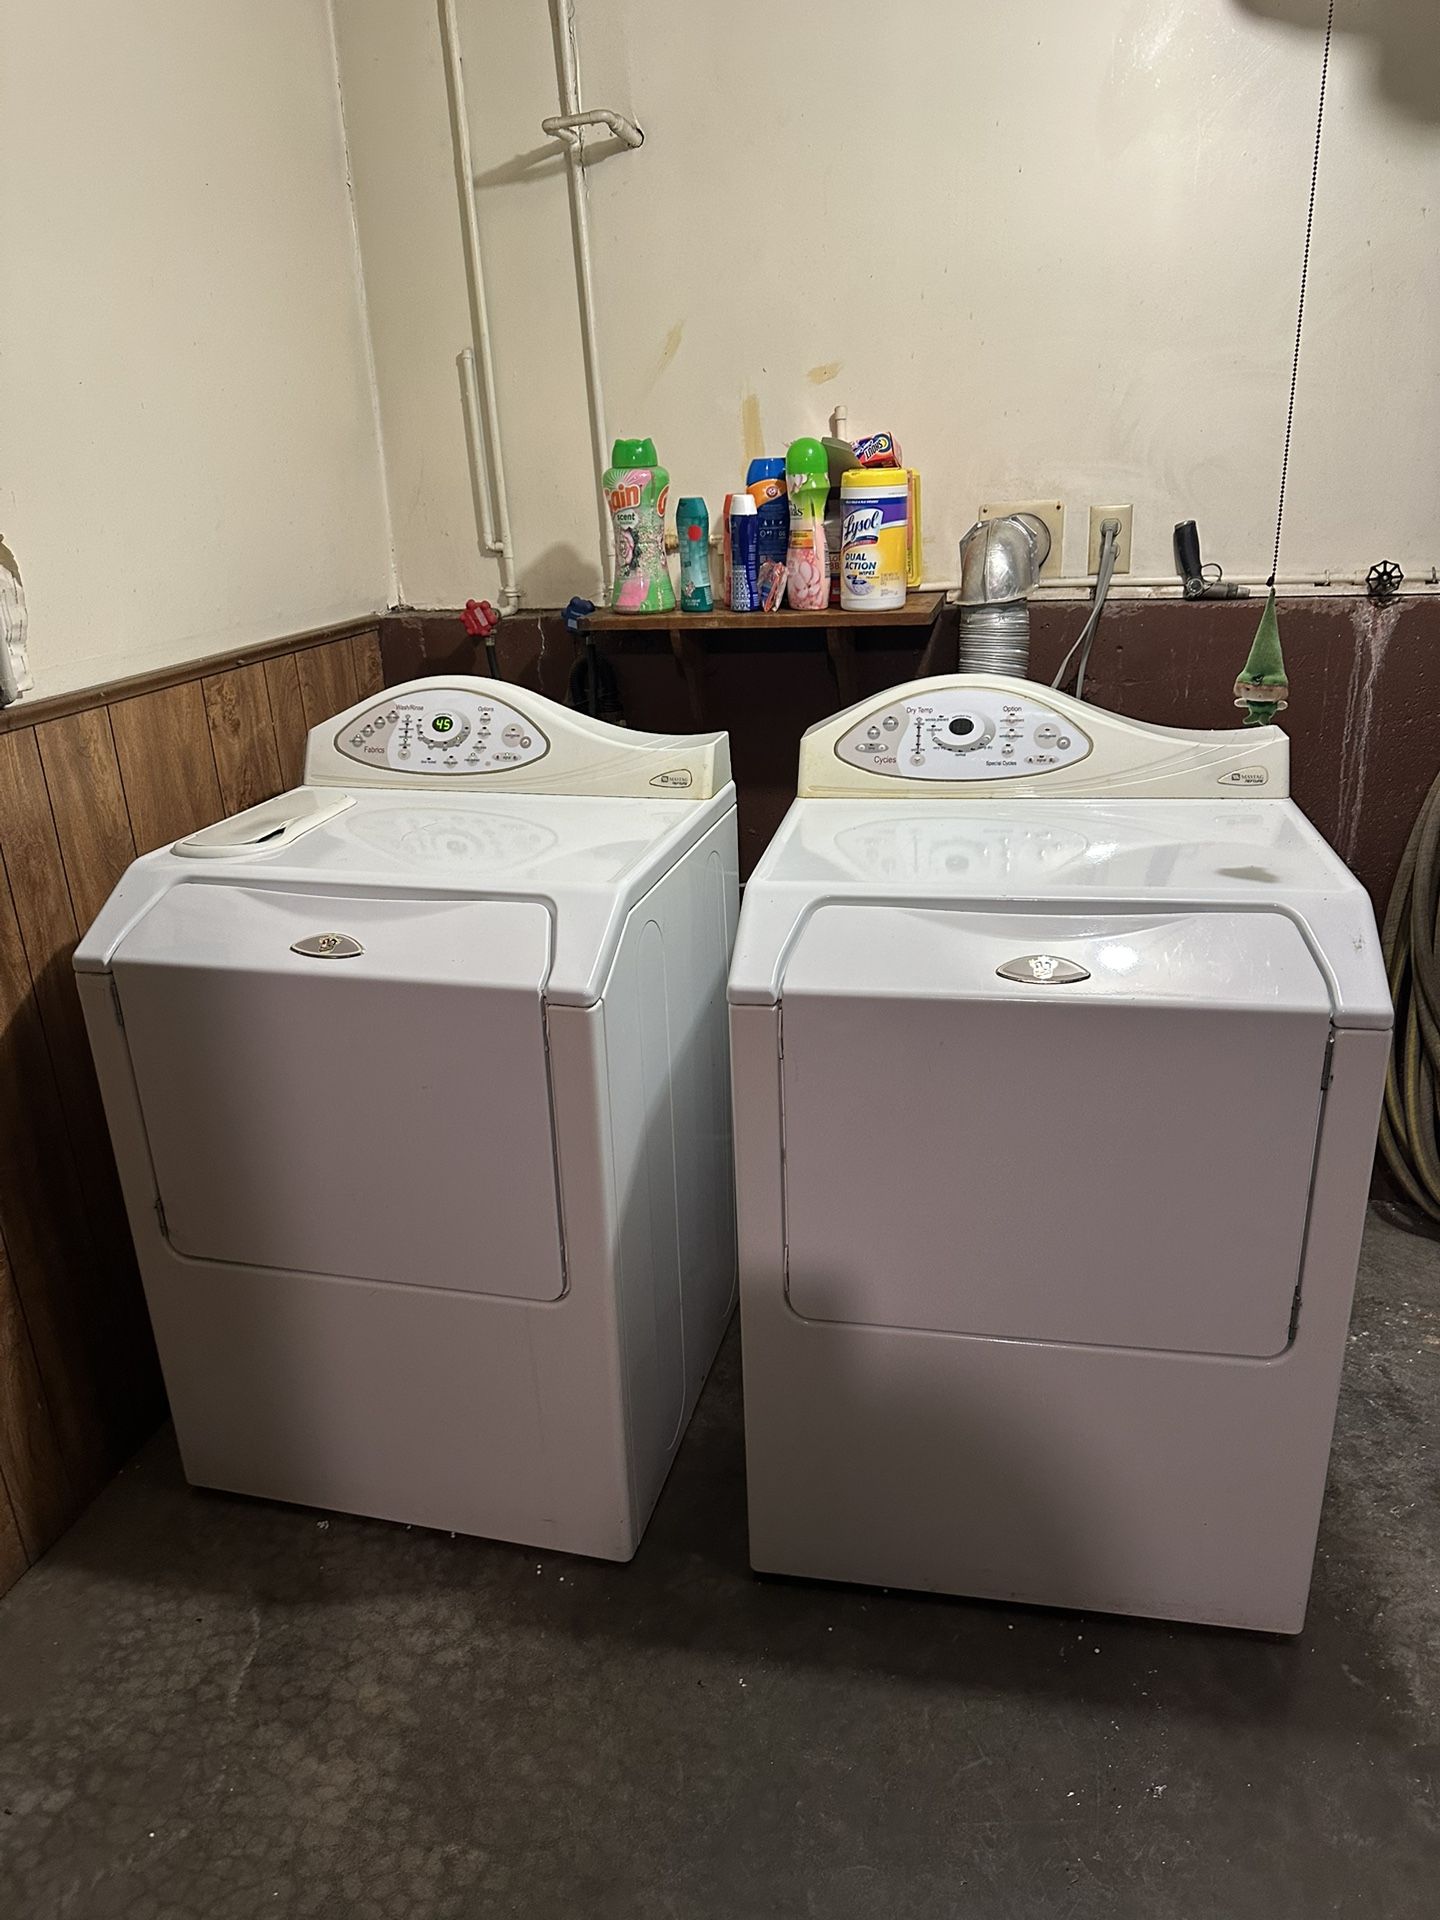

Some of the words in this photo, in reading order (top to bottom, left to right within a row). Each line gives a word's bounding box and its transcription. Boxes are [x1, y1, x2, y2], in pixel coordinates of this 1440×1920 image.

[617, 512, 636, 521] scent
[844, 510, 880, 540] Lysol
[844, 553, 867, 561] DUAL
[844, 562, 877, 570] ACTION
[906, 706, 917, 715] Dry
[918, 706, 934, 715] Temp
[1002, 705, 1023, 713] Option
[435, 718, 451, 730] 45
[363, 745, 386, 754] Fabrics
[873, 755, 898, 766] Cycles
